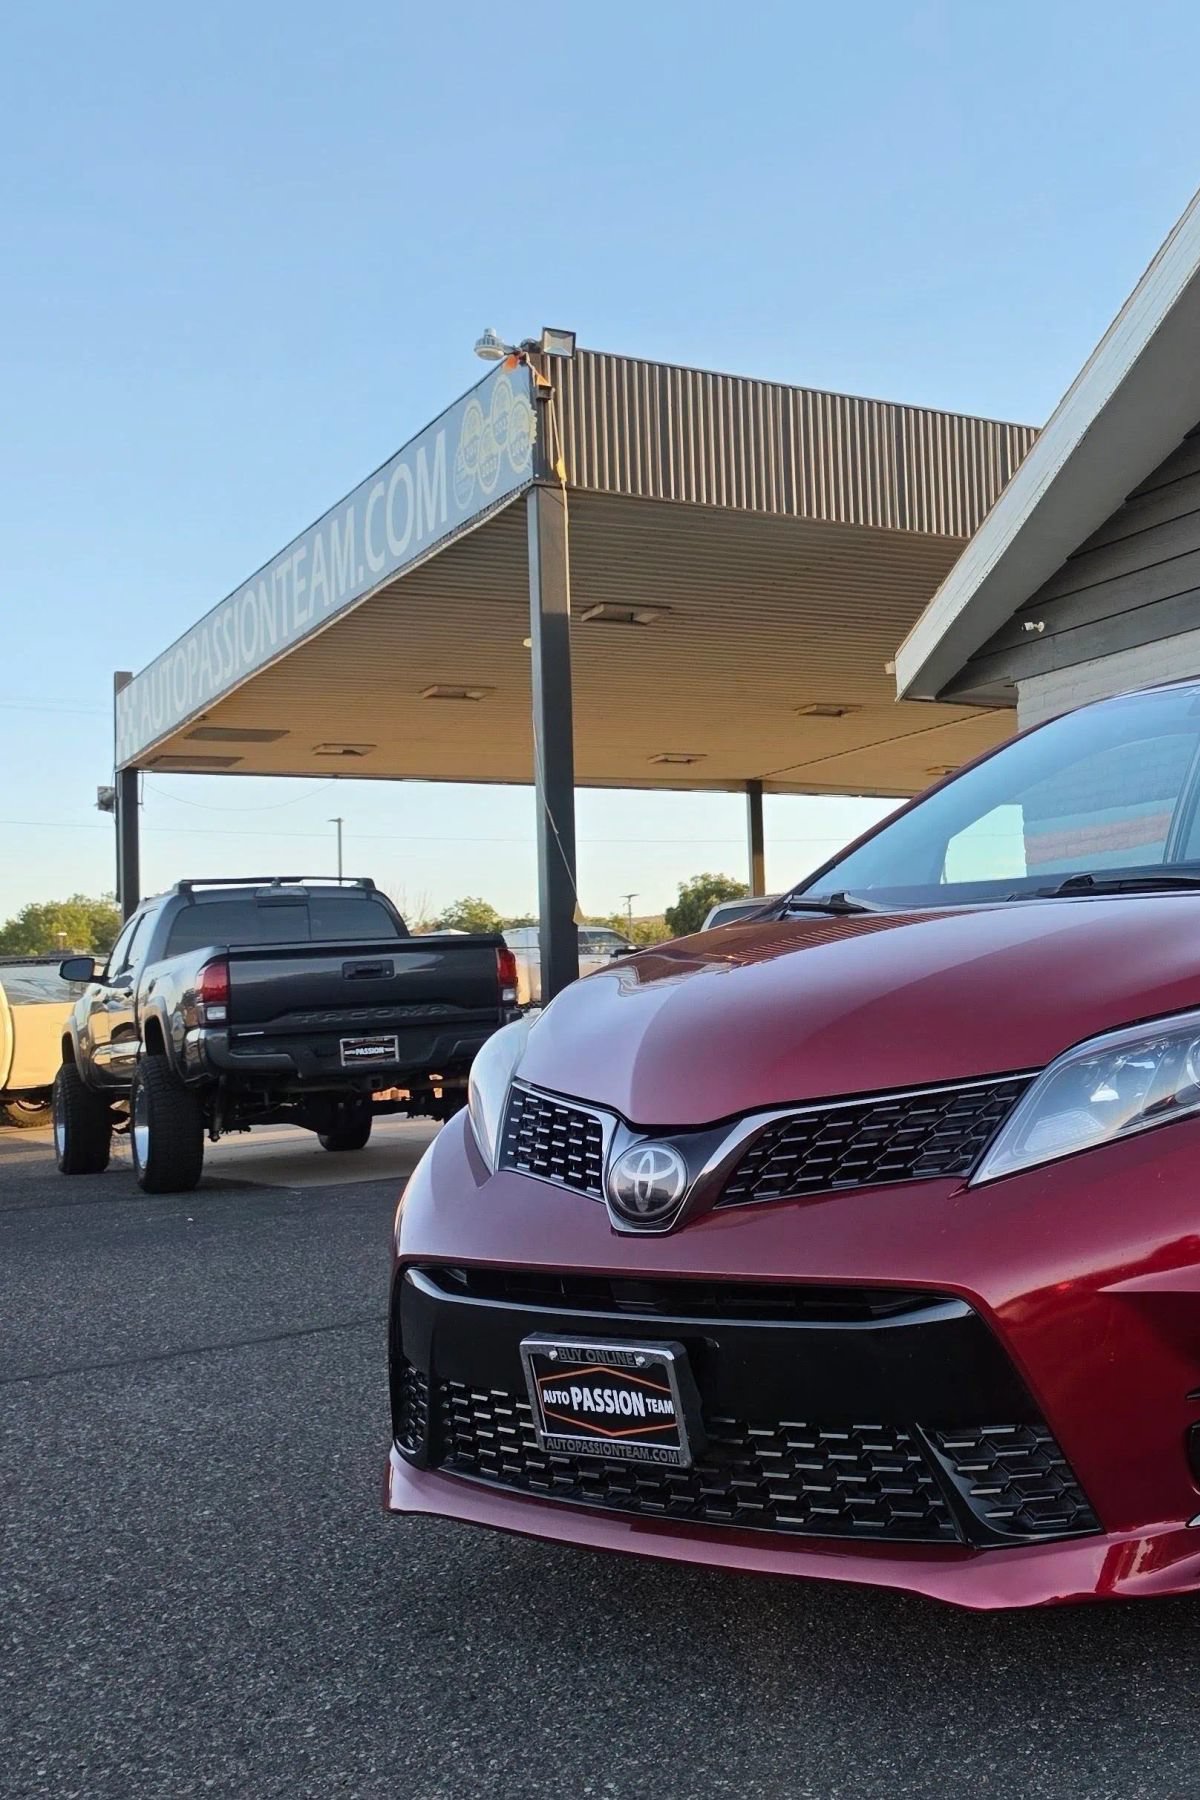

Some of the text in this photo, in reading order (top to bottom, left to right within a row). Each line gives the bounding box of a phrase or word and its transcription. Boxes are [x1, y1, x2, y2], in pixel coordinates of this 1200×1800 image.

[140, 428, 448, 736] AUTOPASSIONTEAM.COM
[294, 1003, 448, 1024] TACOMA
[558, 1348, 635, 1365] BUY ONLINE
[543, 1386, 675, 1417] AUTO PASSION TEAM
[546, 1438, 680, 1464] AUTOPASSIONTEAM.COM
